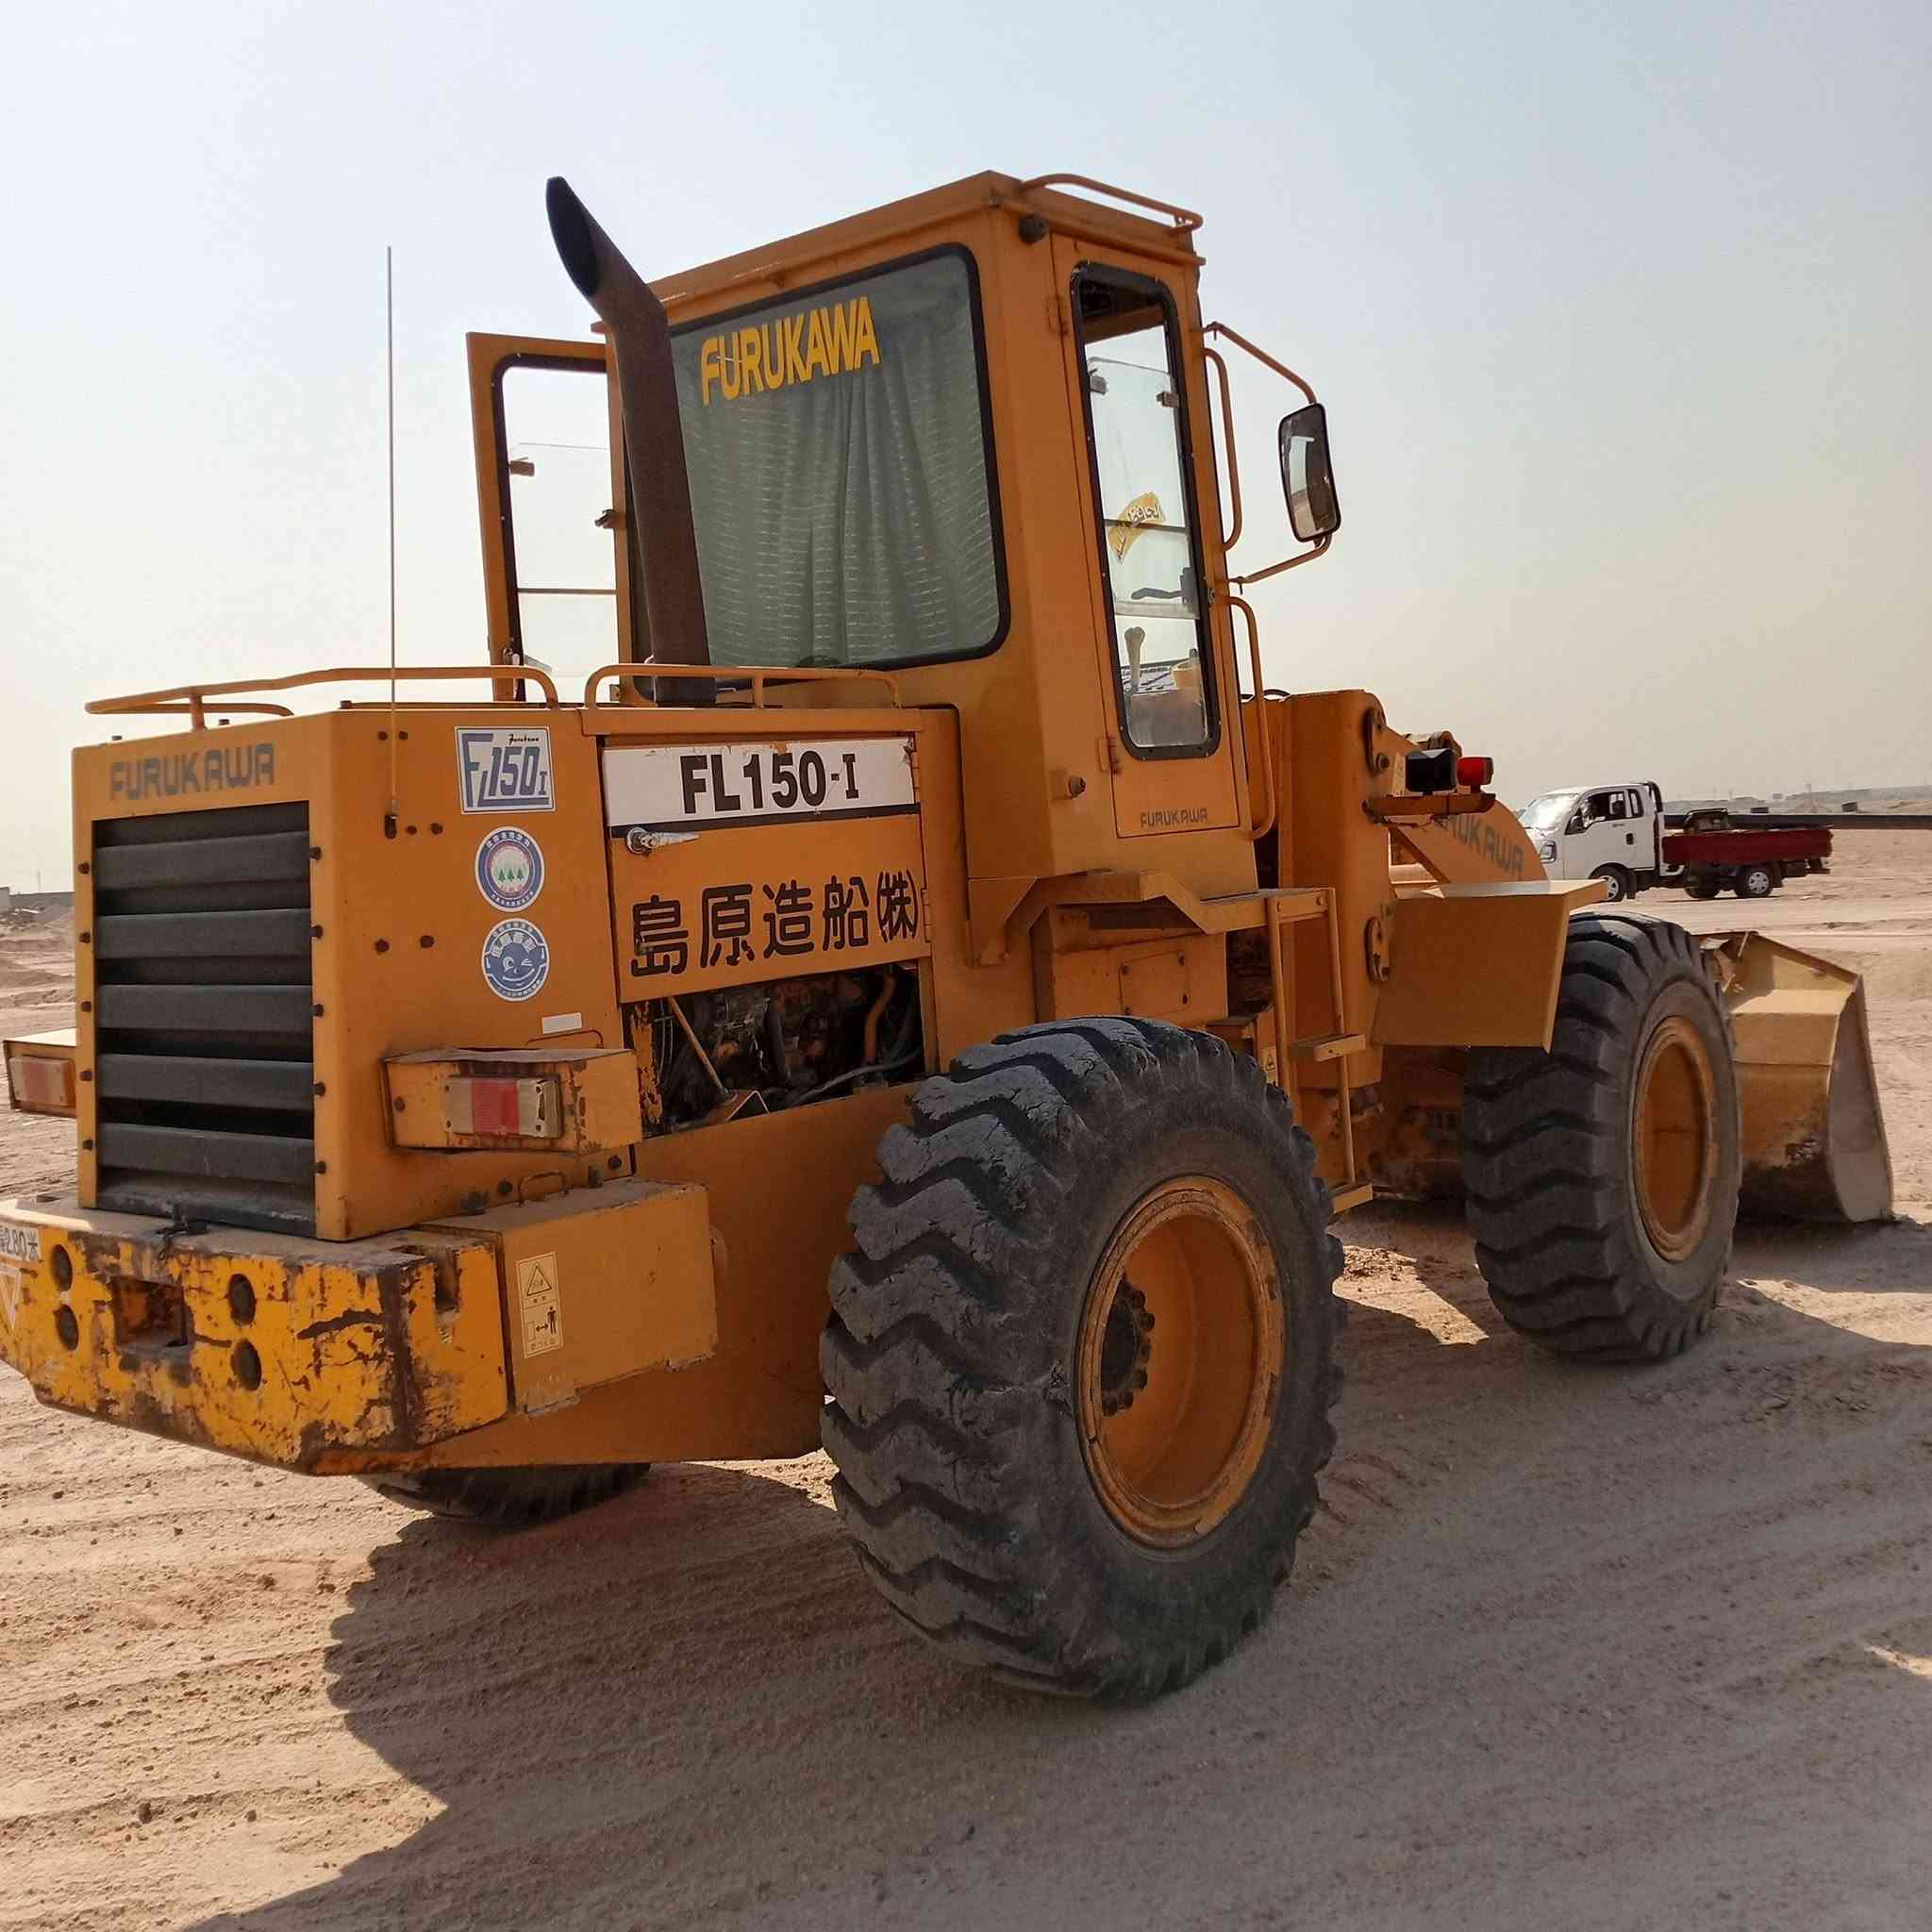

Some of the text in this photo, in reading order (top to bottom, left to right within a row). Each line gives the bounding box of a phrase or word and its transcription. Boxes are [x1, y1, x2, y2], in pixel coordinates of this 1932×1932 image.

[700, 294, 880, 407] FURUKAWA
[109, 742, 275, 800] FURUKAWA
[1140, 808, 1208, 828] FURUKAWA
